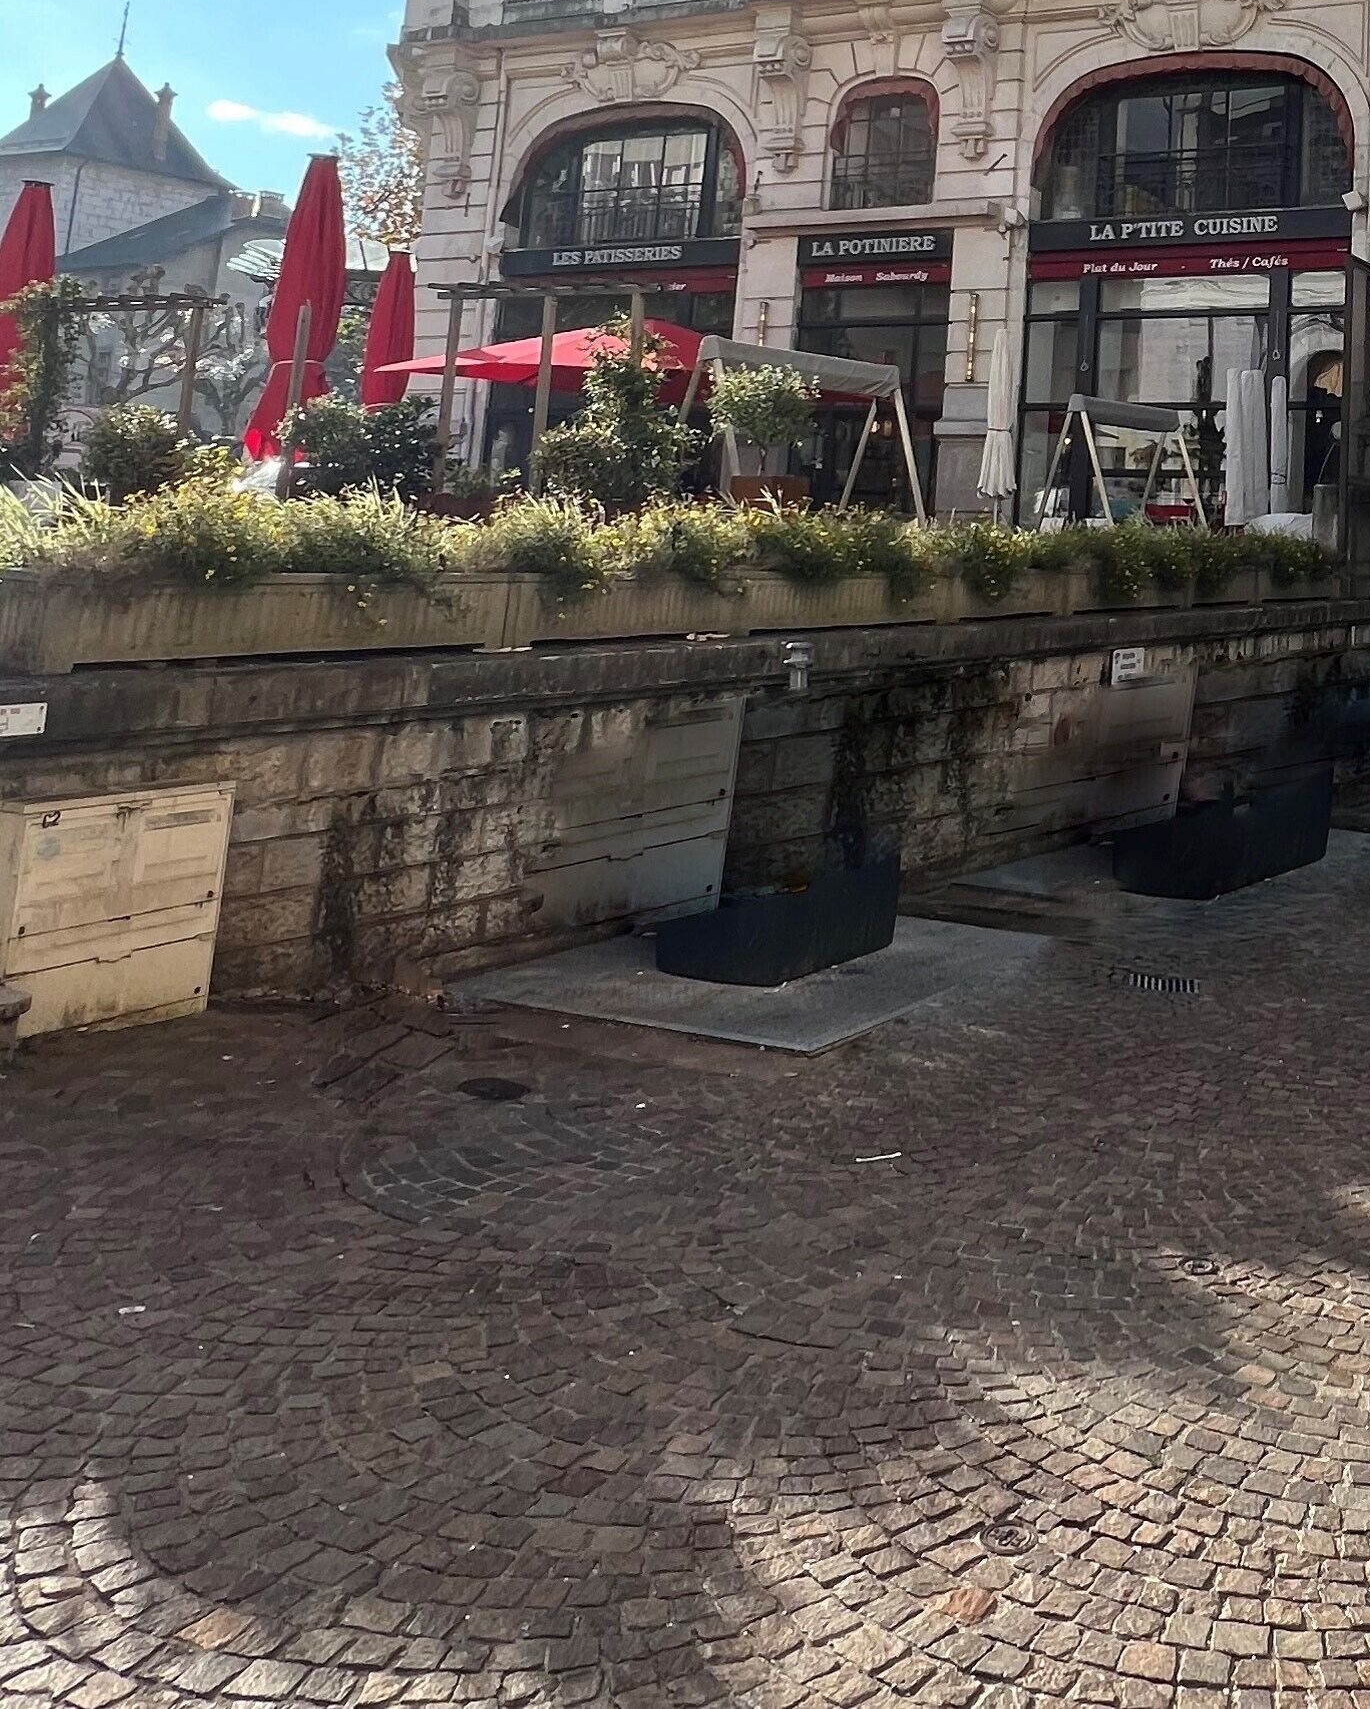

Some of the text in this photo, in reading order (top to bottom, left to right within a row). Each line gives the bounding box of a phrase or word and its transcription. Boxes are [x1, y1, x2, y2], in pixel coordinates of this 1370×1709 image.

[1089, 216, 1279, 241] LA P'TITE CUISINE
[552, 245, 683, 266] LES PATISSERIES
[811, 235, 937, 257] LA POTINIERE
[1082, 263, 1107, 274] Plat
[1110, 262, 1126, 272] du
[1128, 261, 1158, 272] Jour
[1209, 257, 1240, 269] Thés
[1252, 255, 1289, 269] Cafés
[824, 273, 864, 283] Maison
